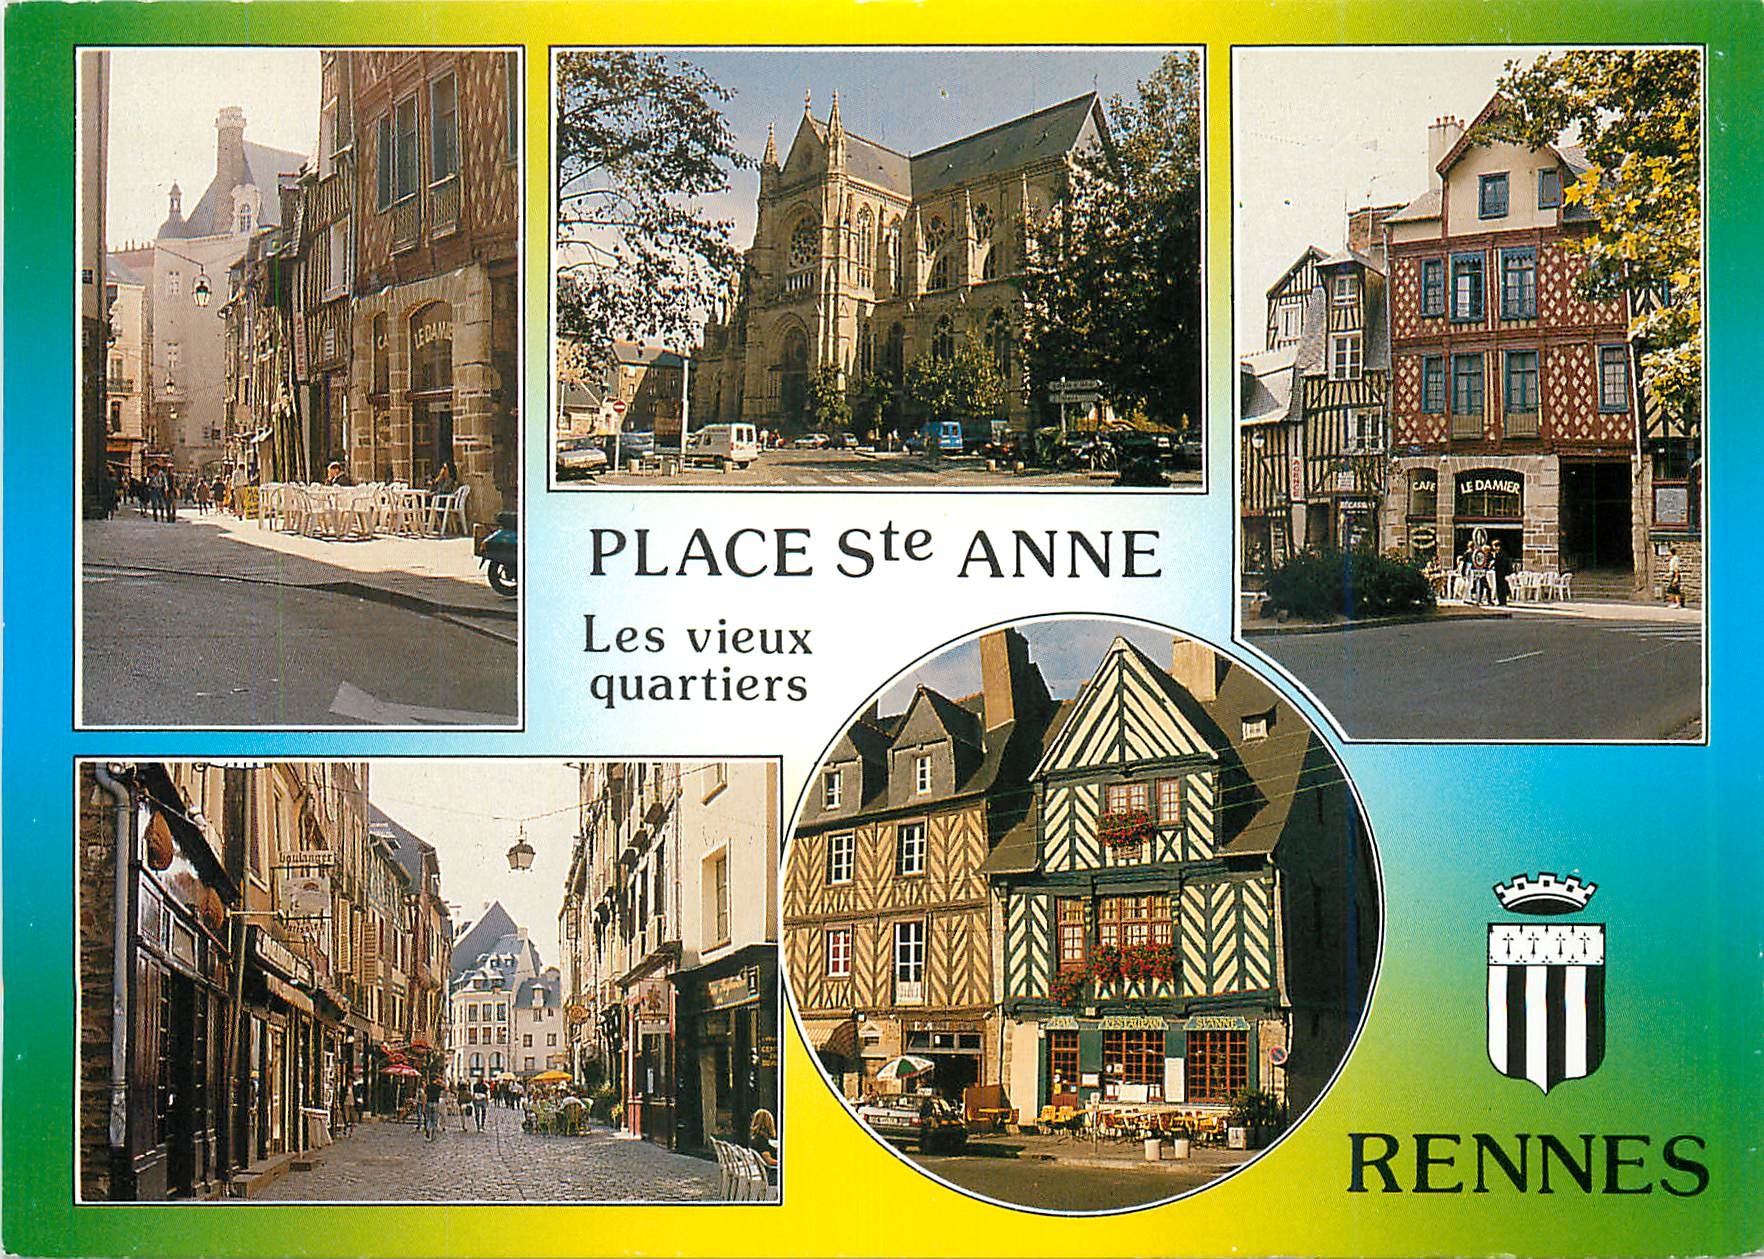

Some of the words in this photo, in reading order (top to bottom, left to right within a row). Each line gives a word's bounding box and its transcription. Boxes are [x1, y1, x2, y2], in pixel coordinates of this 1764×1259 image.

[415, 327, 425, 350] LE
[1460, 480, 1474, 494] LE
[1475, 479, 1521, 494] DAMIER
